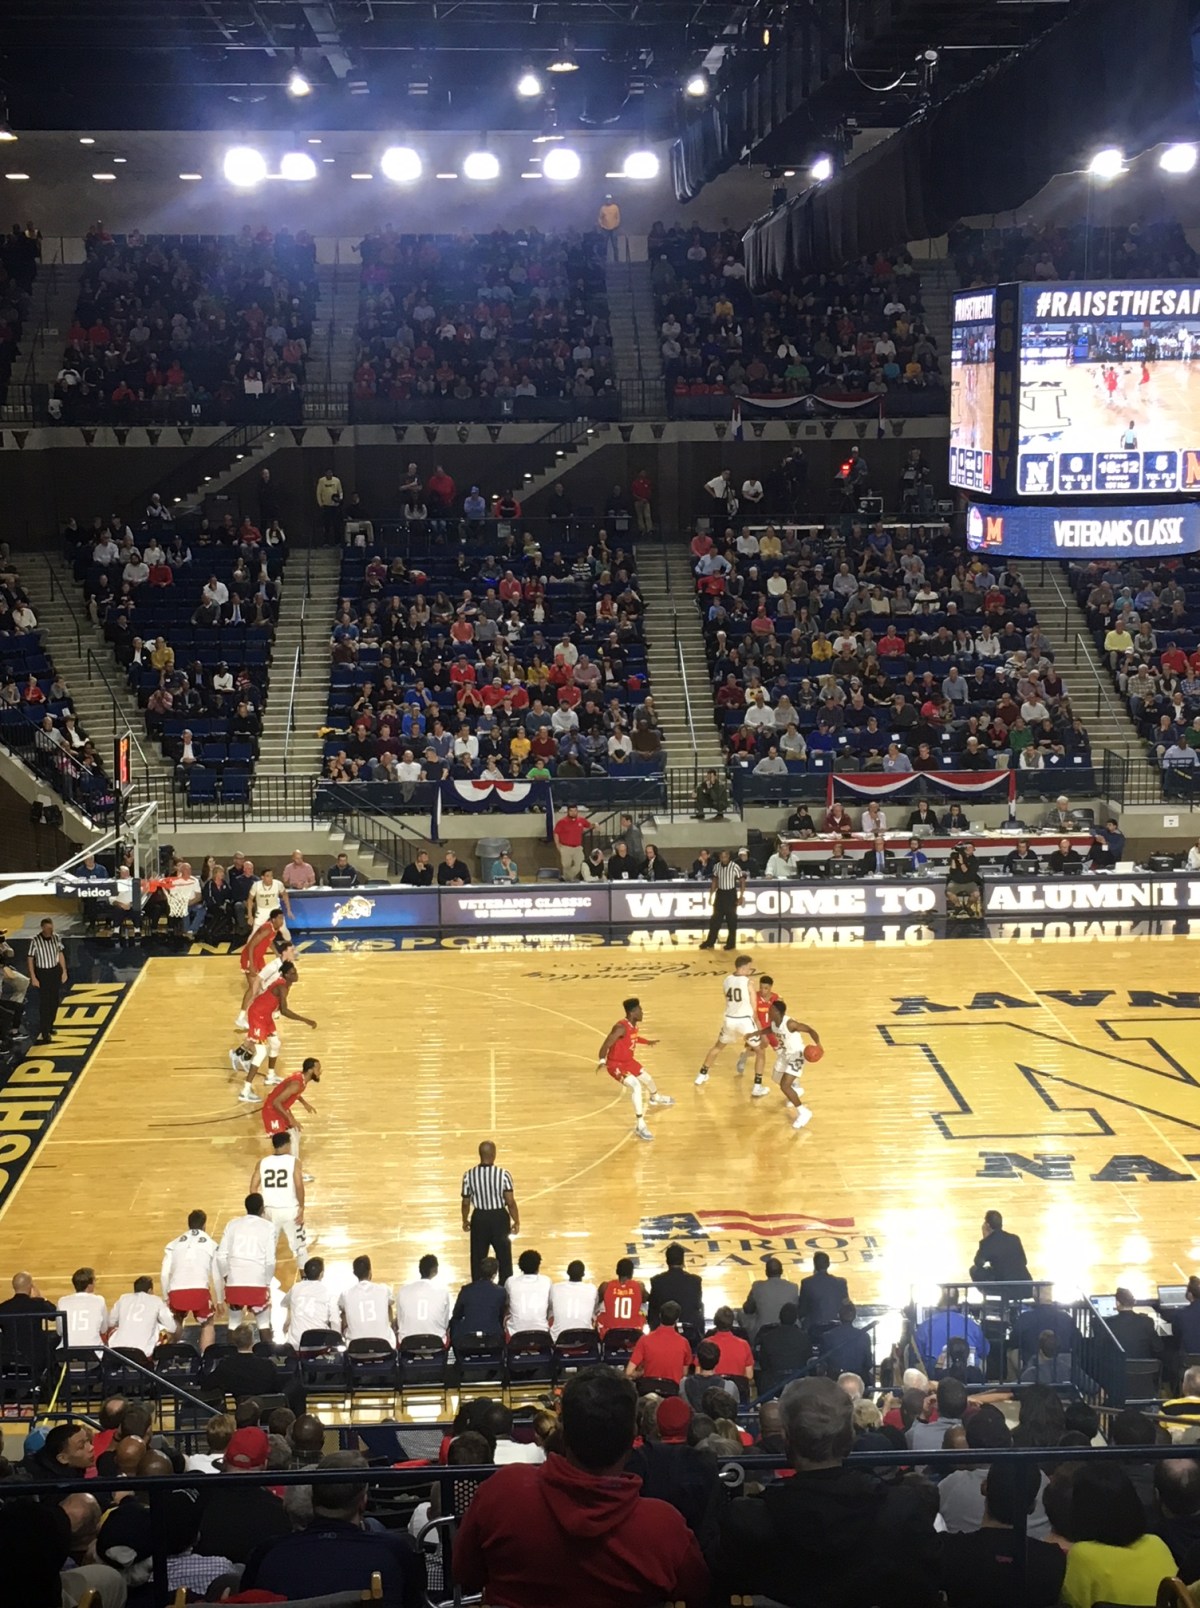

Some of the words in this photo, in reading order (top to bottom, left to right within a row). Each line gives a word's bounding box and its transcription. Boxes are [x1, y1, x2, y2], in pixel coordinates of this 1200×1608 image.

[191, 404, 201, 413] M
[503, 401, 511, 411] L
[805, 398, 814, 407] K
[986, 517, 1003, 541] M
[1054, 520, 1133, 547] VETERANS
[77, 887, 112, 898] leidos
[458, 898, 533, 910] VETERANS
[534, 897, 592, 908] CLASSIC
[625, 887, 866, 918] WELCOME
[875, 887, 936, 913] TO
[987, 882, 1178, 910] ALUMNI
[725, 987, 743, 1003] 40
[0, 982, 126, 1196] SHIPMEN
[976, 1151, 1200, 1182] NA
[264, 1168, 288, 1188] 22
[126, 1303, 146, 1321] 12
[358, 1300, 377, 1322] 13
[416, 1298, 428, 1320] 0
[614, 1296, 632, 1319] 10
[71, 1309, 90, 1331] 15
